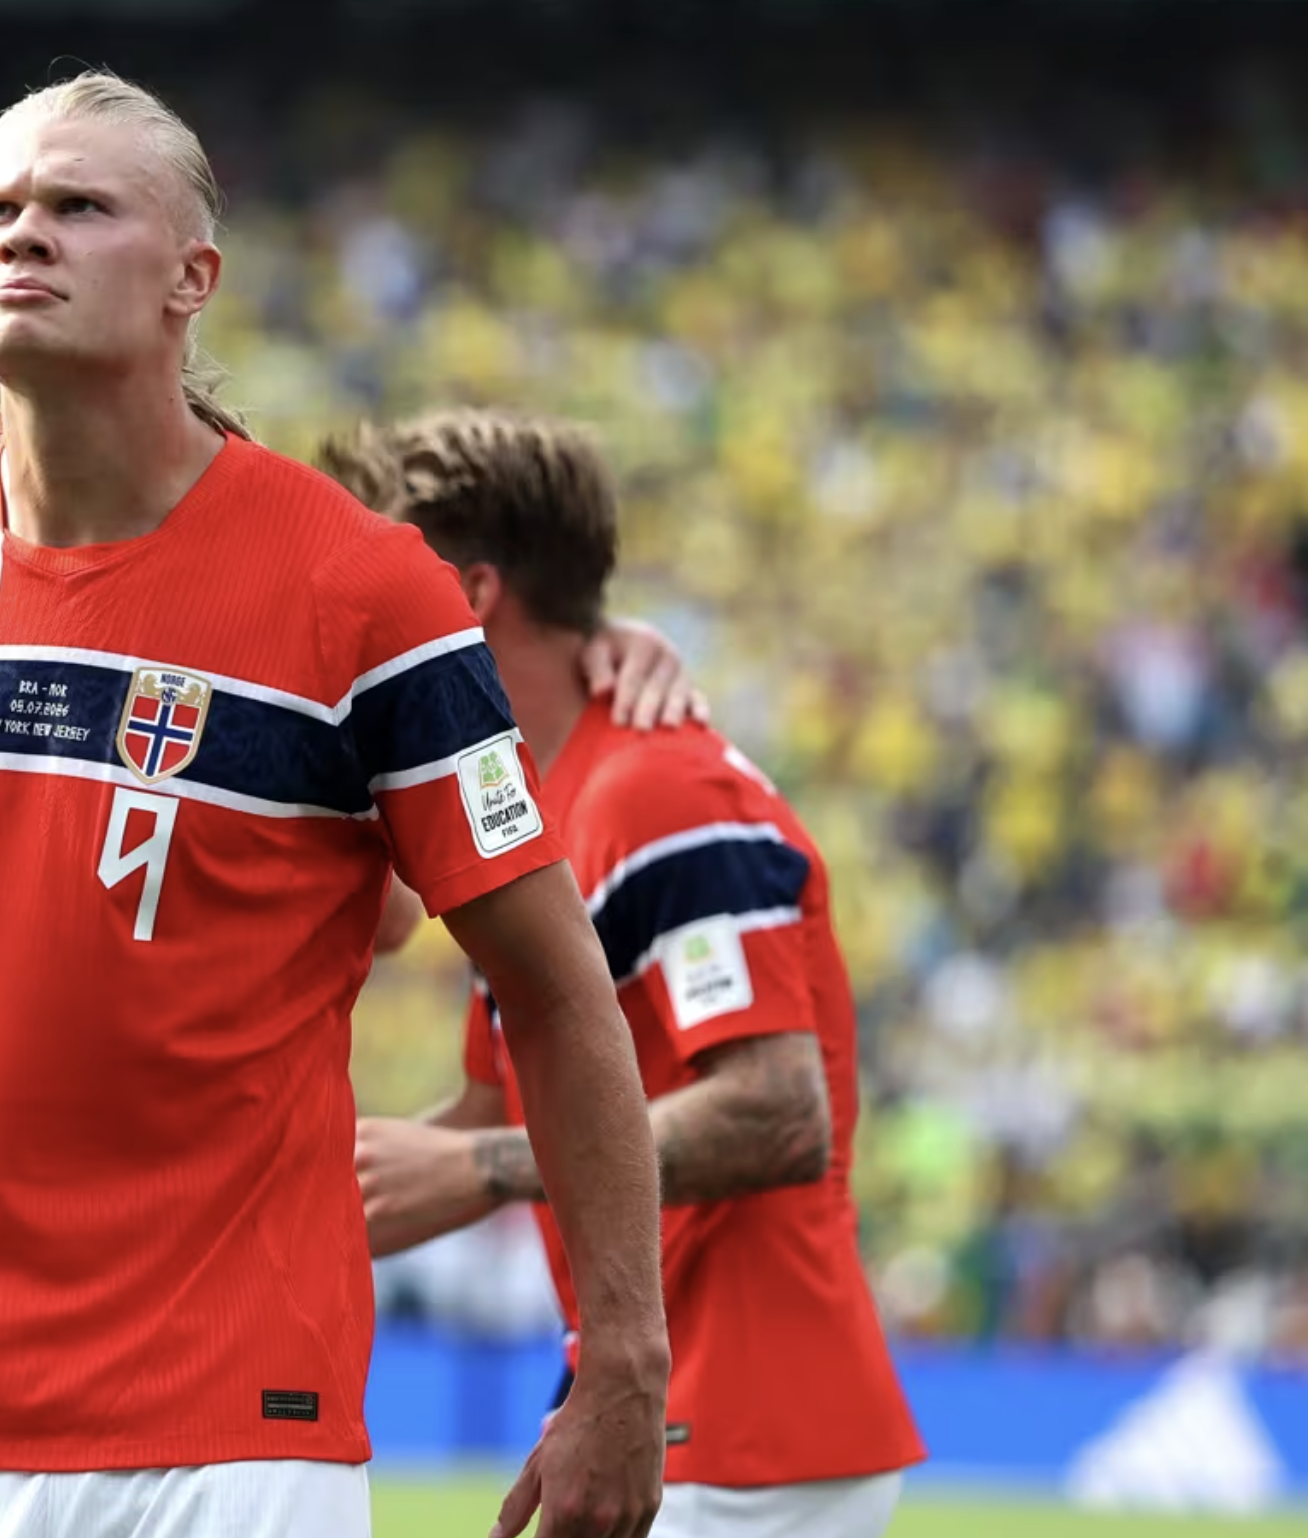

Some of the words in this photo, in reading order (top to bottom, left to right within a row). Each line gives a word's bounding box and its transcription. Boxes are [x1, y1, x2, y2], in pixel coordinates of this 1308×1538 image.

[19, 680, 38, 695] BRA
[48, 683, 68, 697] NOR
[160, 673, 186, 687] NORGE
[10, 699, 70, 717] 05.07.2026
[4, 719, 31, 735] YORK
[33, 722, 52, 736] NEW
[53, 724, 90, 741] JERSEY
[481, 799, 528, 832] EDUCATION
[501, 824, 518, 838] FIFA
[97, 786, 180, 941] 9
